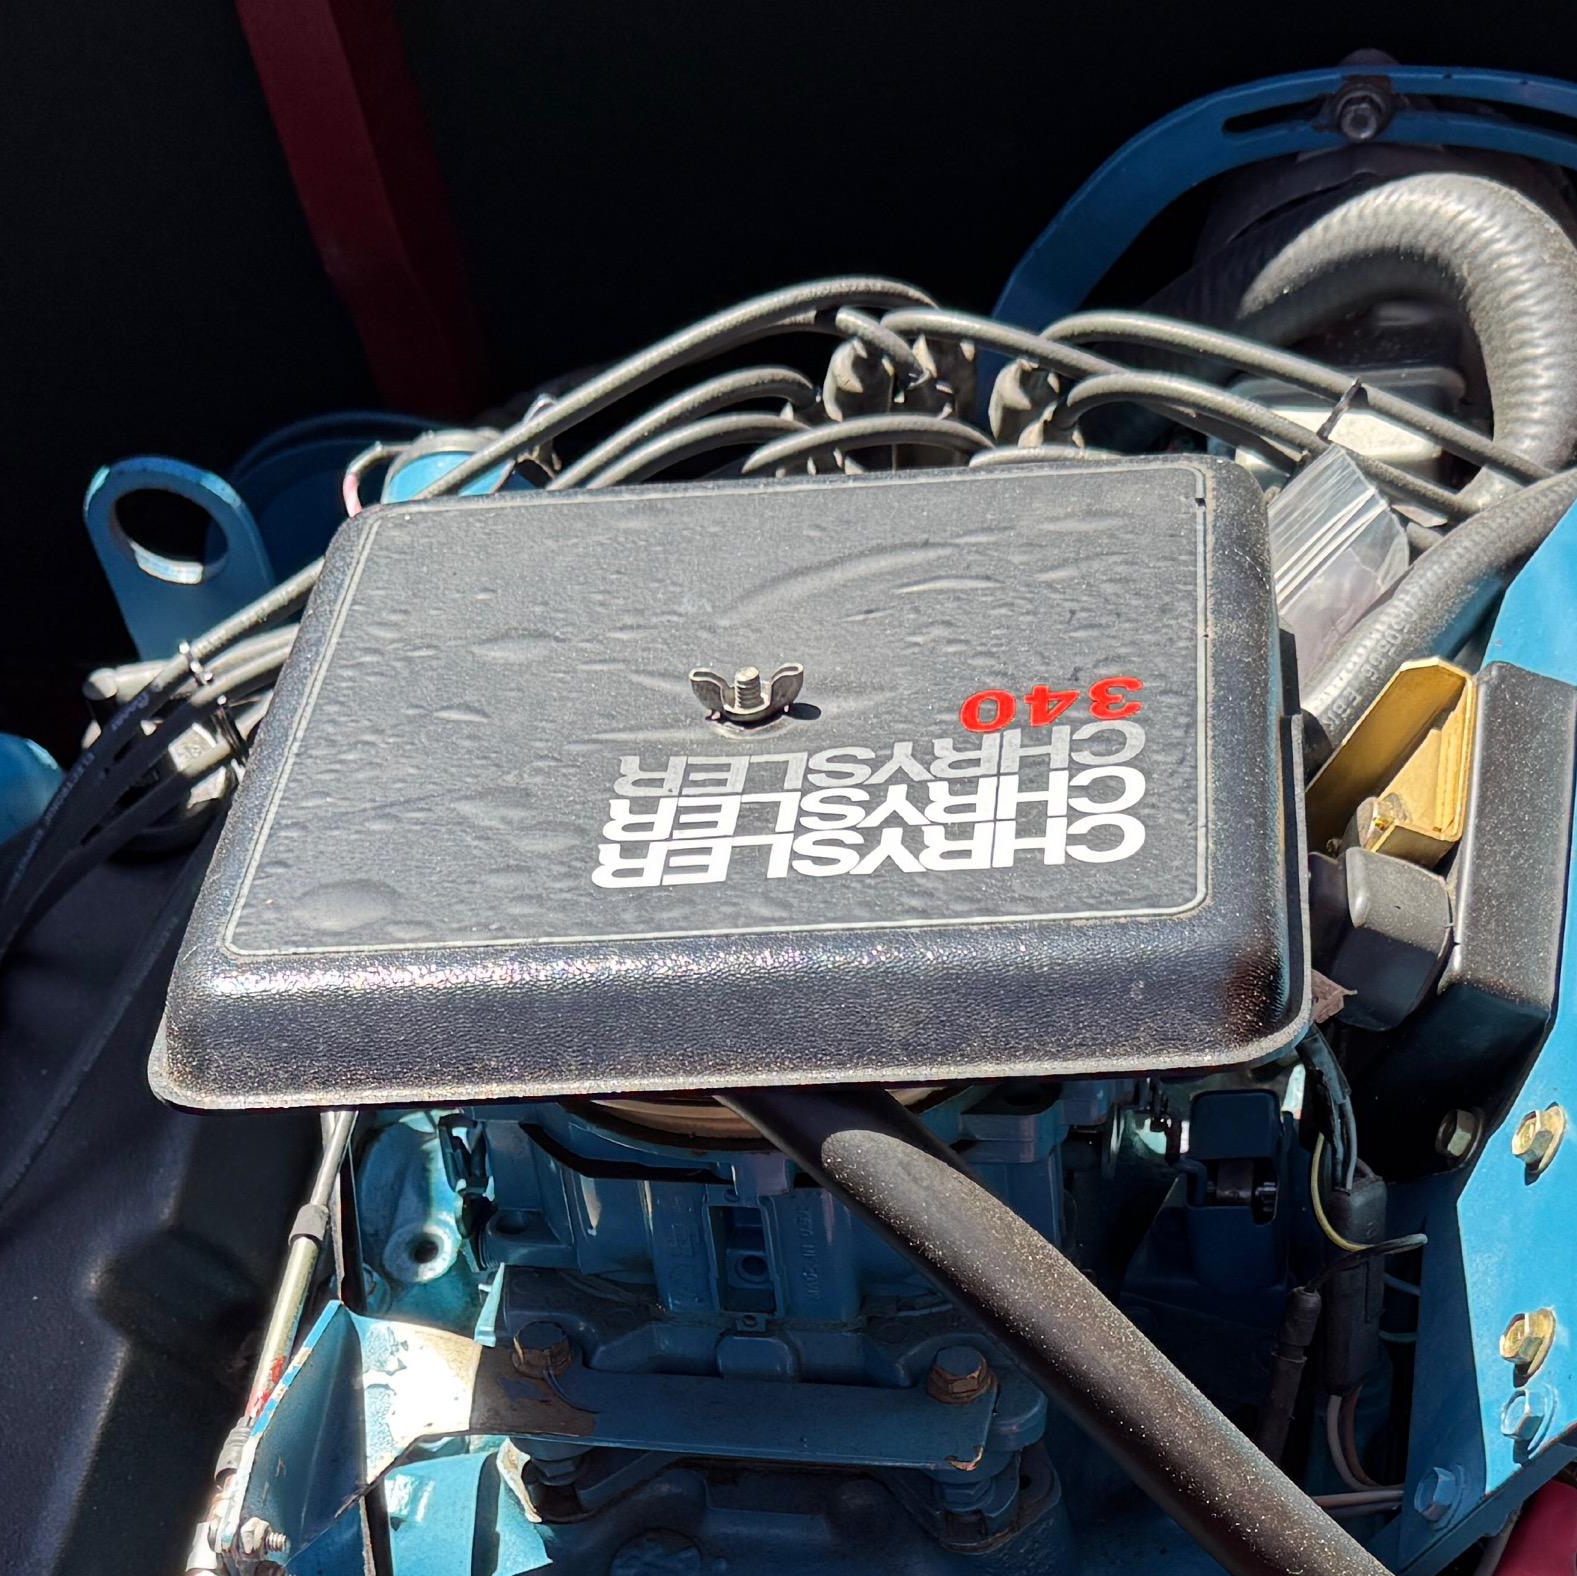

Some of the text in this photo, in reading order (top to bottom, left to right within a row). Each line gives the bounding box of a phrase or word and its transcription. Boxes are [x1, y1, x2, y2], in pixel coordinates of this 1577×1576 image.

[959, 676, 1145, 733] 340
[613, 720, 1146, 798] CHRYSLER
[603, 765, 1146, 843] CHRYSLER
[591, 813, 1146, 889] CHRYSLER
